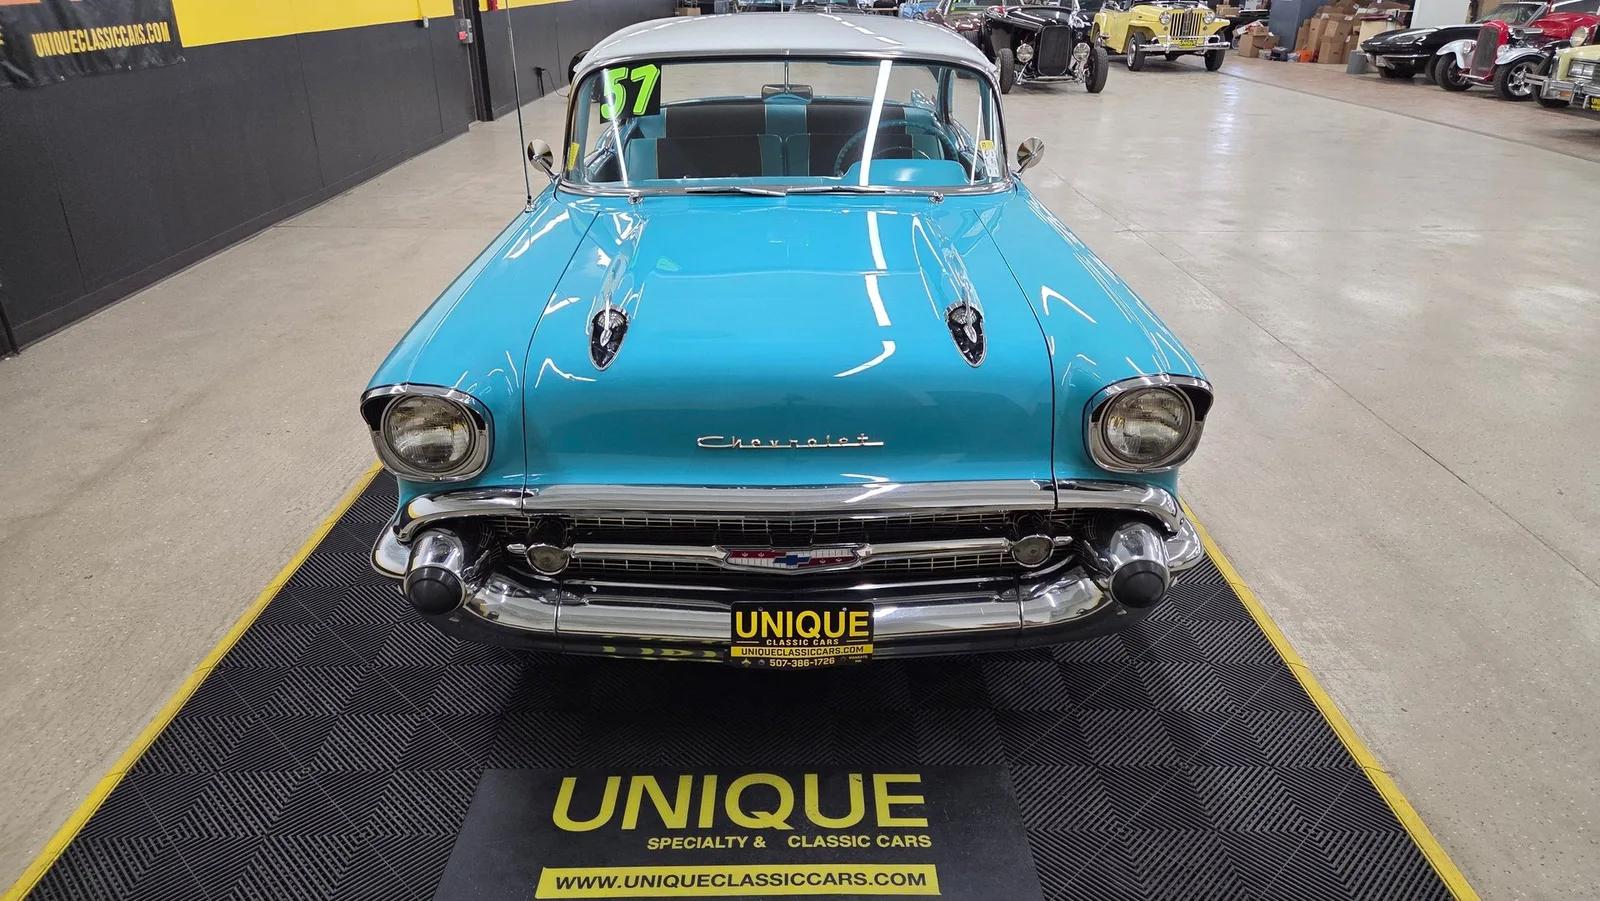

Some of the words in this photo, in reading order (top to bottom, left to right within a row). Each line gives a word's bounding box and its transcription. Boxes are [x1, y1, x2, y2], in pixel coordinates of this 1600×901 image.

[32, 22, 170, 58] UNIQUECLASSICCARS.COM
[600, 64, 660, 120] 57
[697, 433, 884, 448] Chevrolet
[736, 610, 869, 638] UNIQUE
[813, 638, 839, 646] CARS
[741, 646, 864, 657] UNIQUECLASSICCARS.COM
[769, 657, 835, 668] 507-386-1726
[552, 773, 929, 832] UNIQUE
[647, 836, 748, 849] SPECIALTY
[753, 836, 766, 847] &
[787, 836, 870, 848] CLASSIC
[876, 835, 932, 848] CARS
[555, 872, 927, 890] WWW.UNIQUECLASSICCARS.COM
